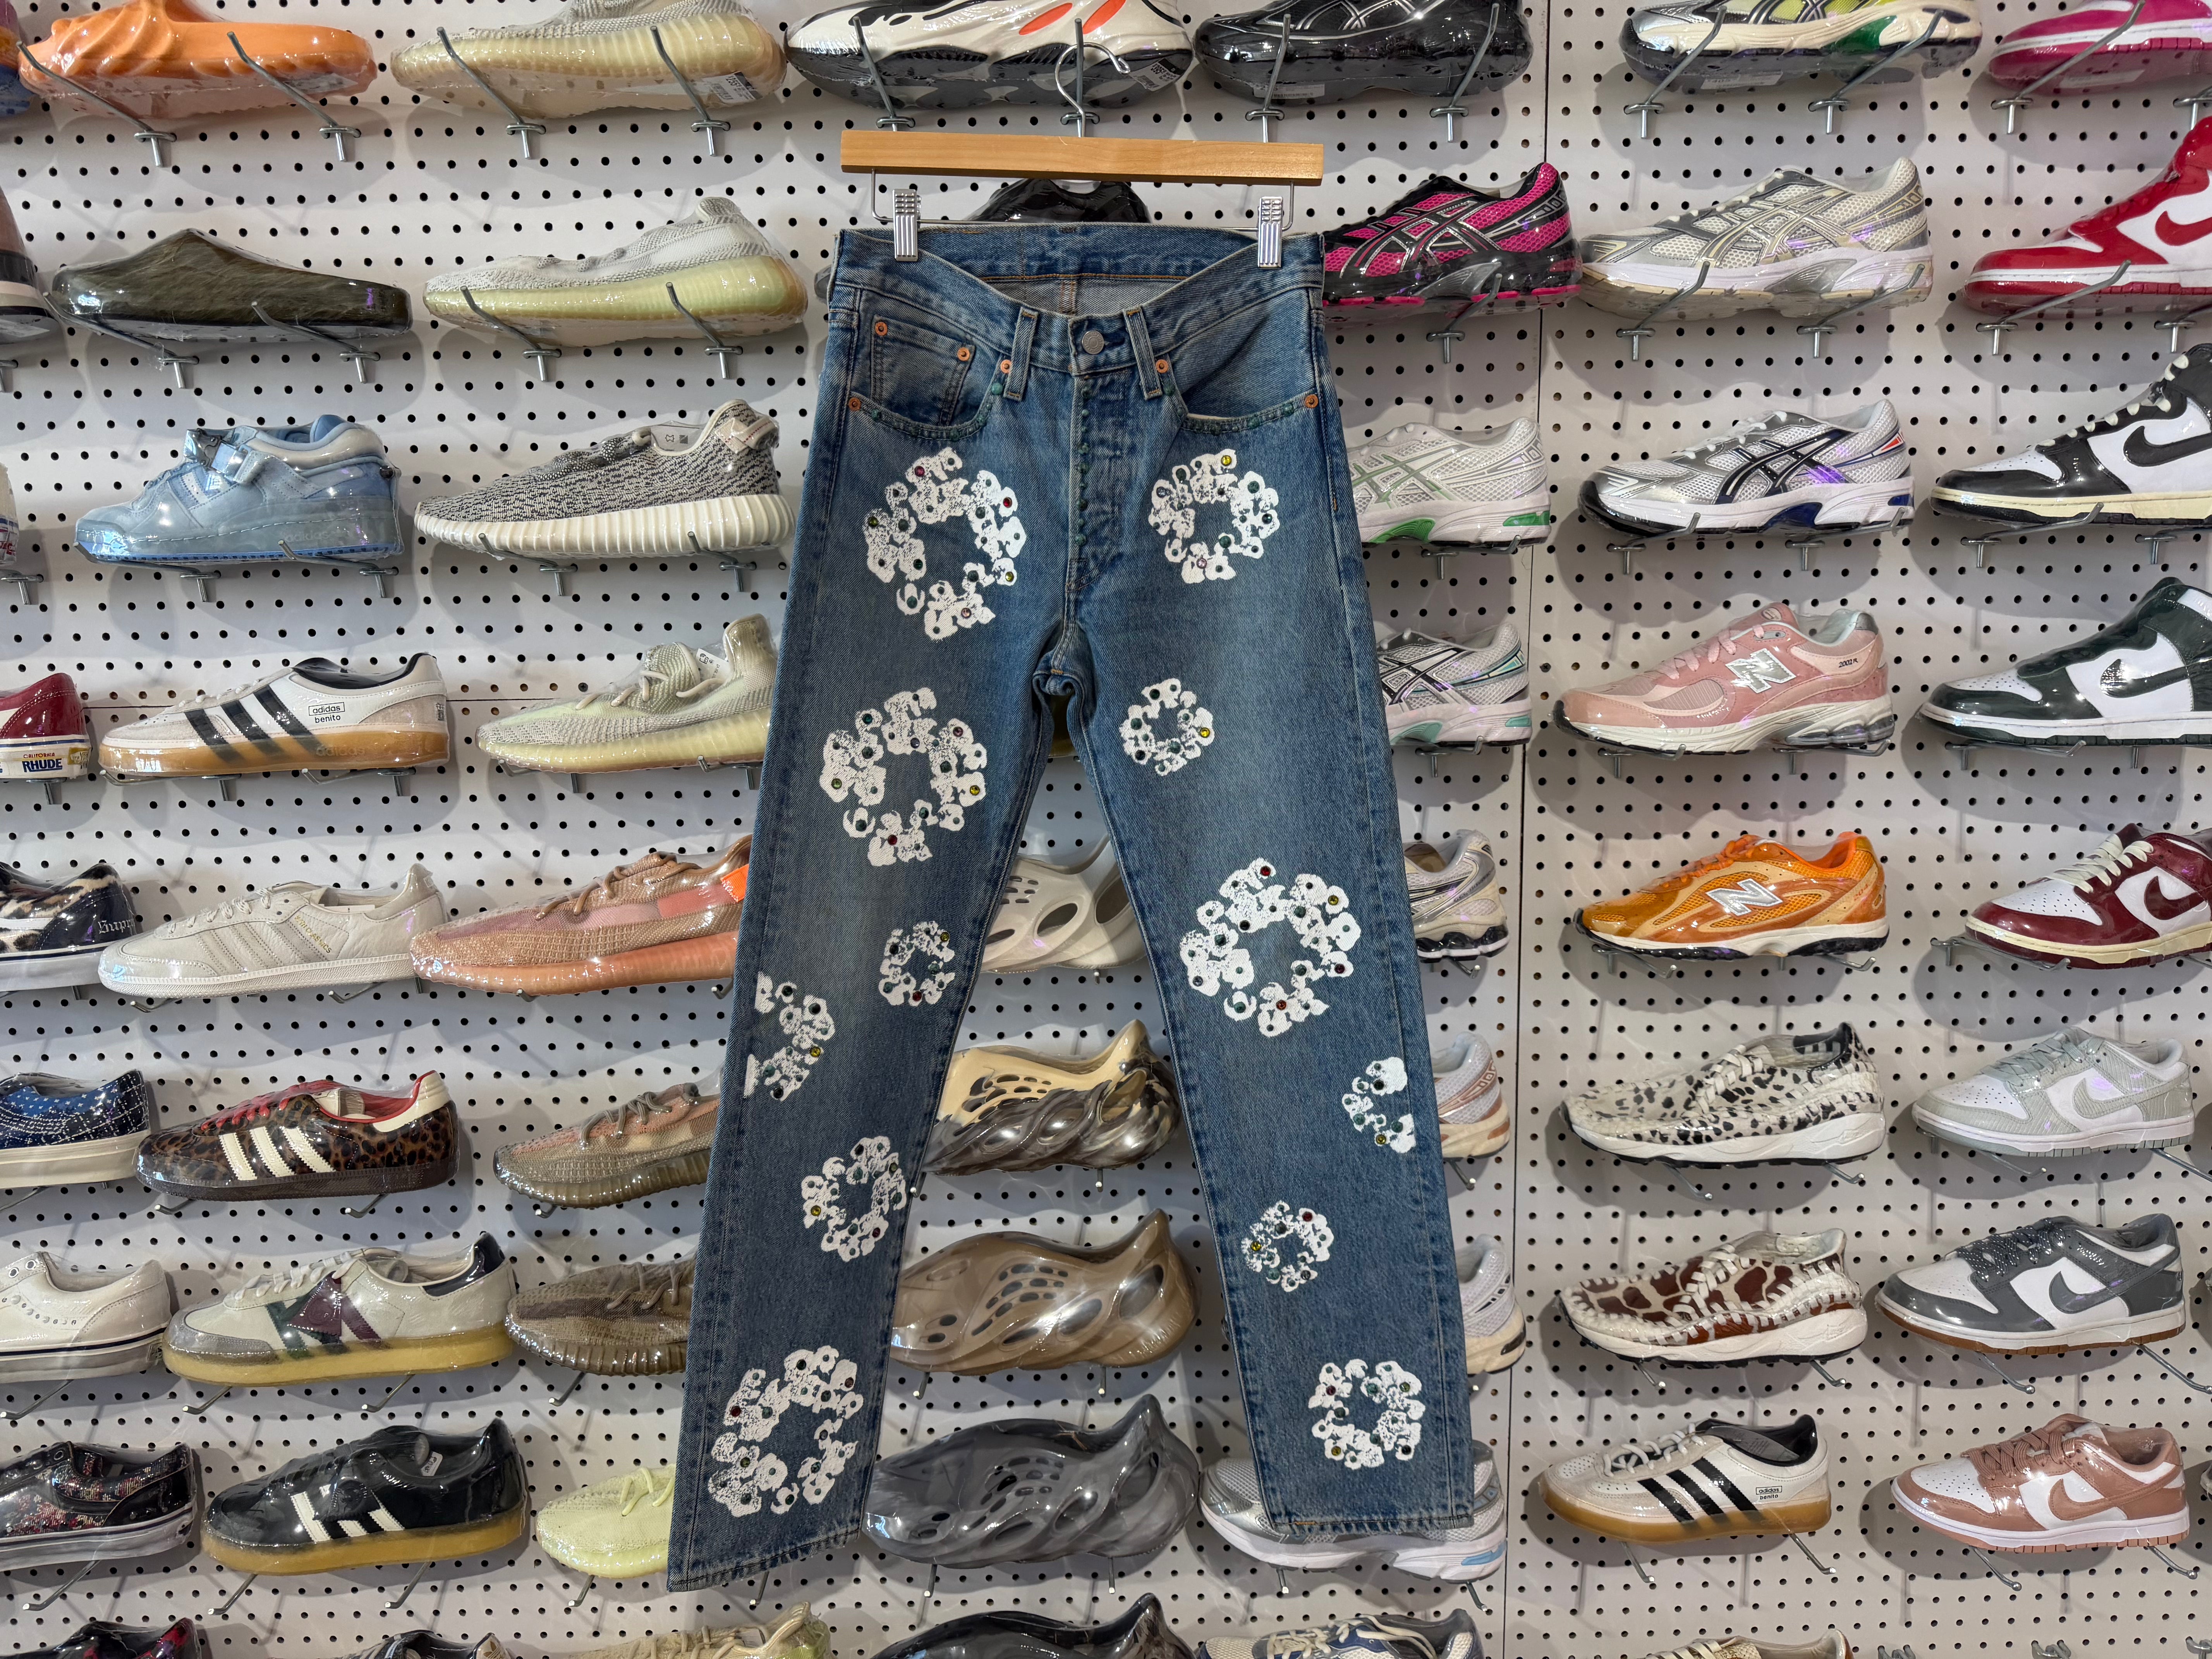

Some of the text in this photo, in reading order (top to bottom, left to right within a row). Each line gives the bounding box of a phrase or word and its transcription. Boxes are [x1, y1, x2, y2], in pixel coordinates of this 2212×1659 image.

[313, 705, 340, 713] adidas
[314, 714, 341, 723] benito
[316, 744, 366, 756] adidas
[22, 758, 63, 773] RHUDE
[1705, 878, 1783, 916] N
